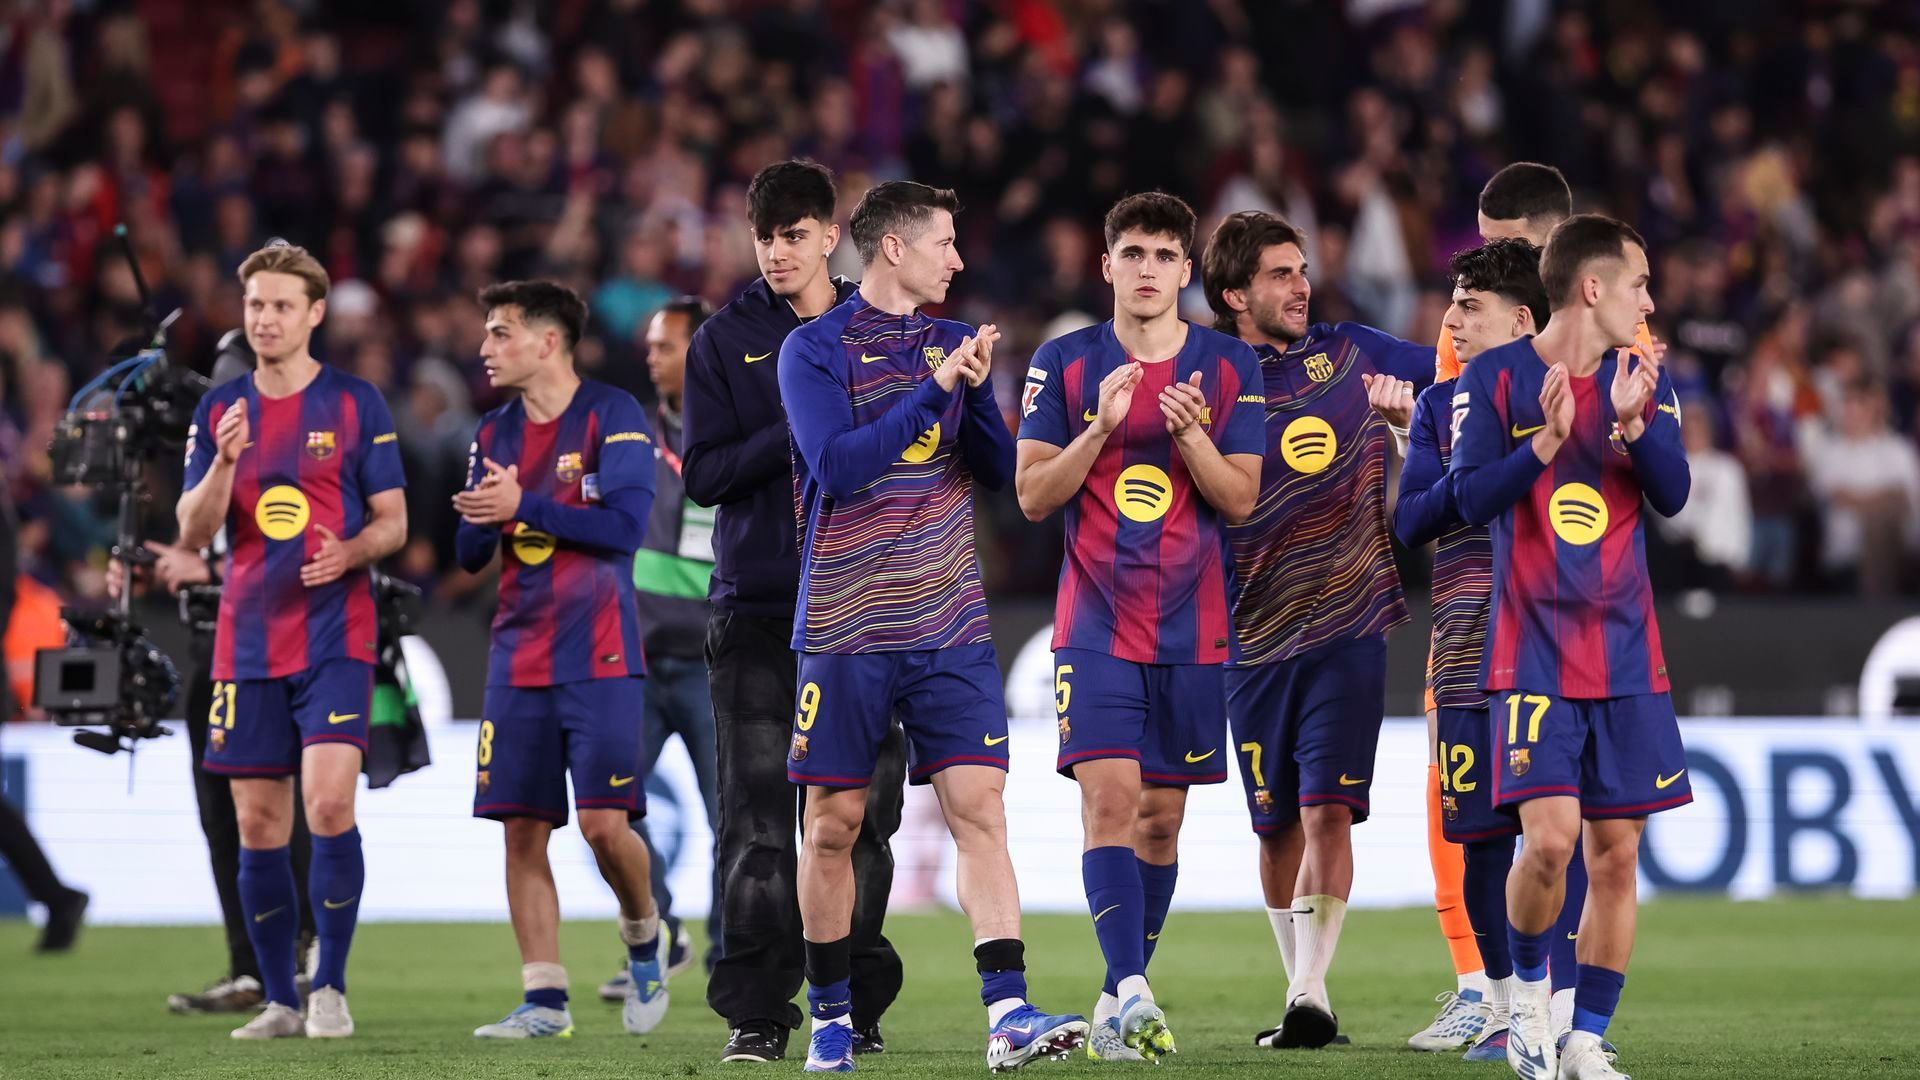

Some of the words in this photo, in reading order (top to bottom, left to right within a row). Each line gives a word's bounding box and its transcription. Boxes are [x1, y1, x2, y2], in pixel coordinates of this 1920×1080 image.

[209, 681, 237, 730] 21
[797, 682, 821, 731] 9
[1056, 664, 1073, 713] 5
[479, 720, 495, 767] 8
[1505, 694, 1551, 745] 17
[1241, 742, 1265, 787] 7
[1440, 741, 1477, 792] 42
